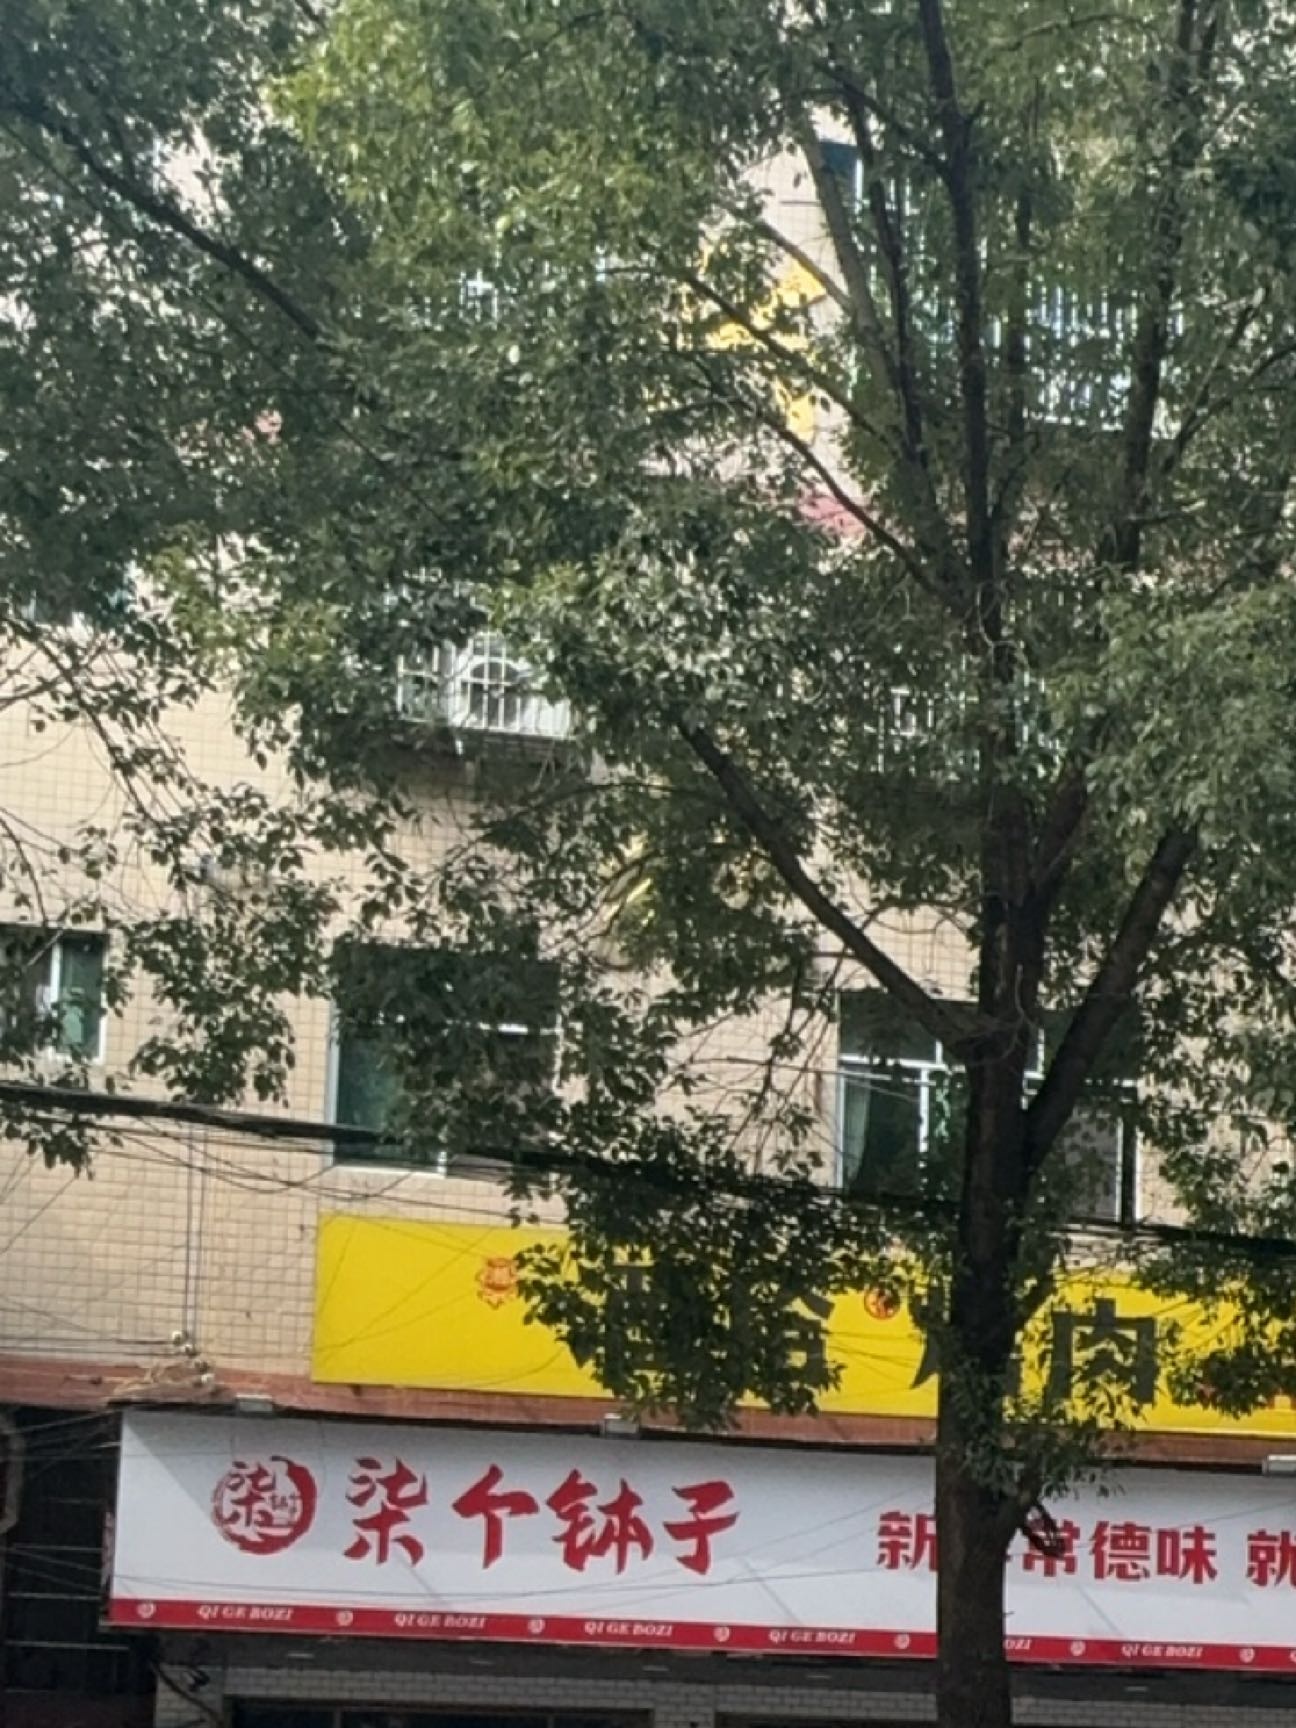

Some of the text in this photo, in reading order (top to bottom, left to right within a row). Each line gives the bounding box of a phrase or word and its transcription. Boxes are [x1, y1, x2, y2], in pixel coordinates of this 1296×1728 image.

[343, 1456, 740, 1575] 柒个钵子
[878, 1509, 1218, 1585] 新常德味
